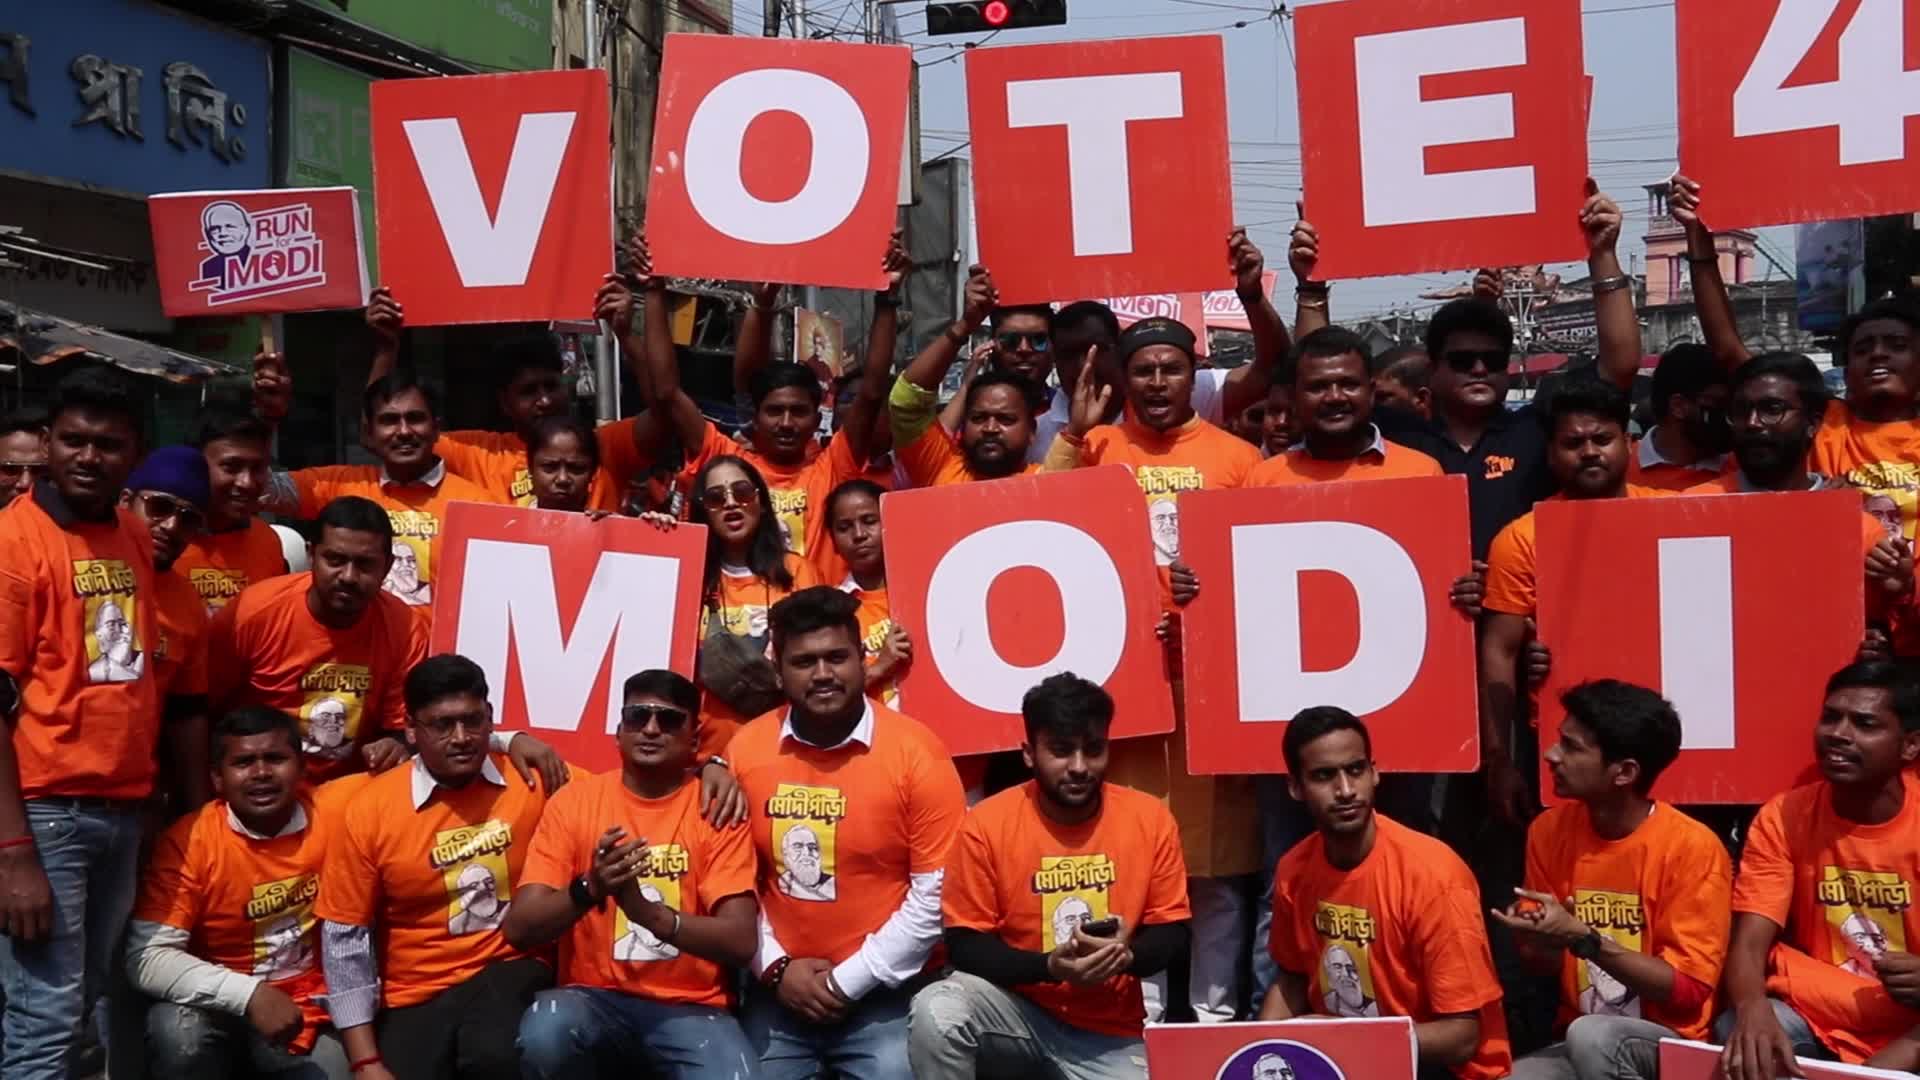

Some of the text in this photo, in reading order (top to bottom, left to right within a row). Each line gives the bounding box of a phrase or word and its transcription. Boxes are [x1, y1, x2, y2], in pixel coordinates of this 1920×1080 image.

[256, 211, 309, 240] RUN
[227, 242, 320, 289] MODI
[1113, 295, 1179, 318] MODI
[765, 790, 847, 825] মোদীপাড়া
[1033, 858, 1116, 894] মোদীপাড়া
